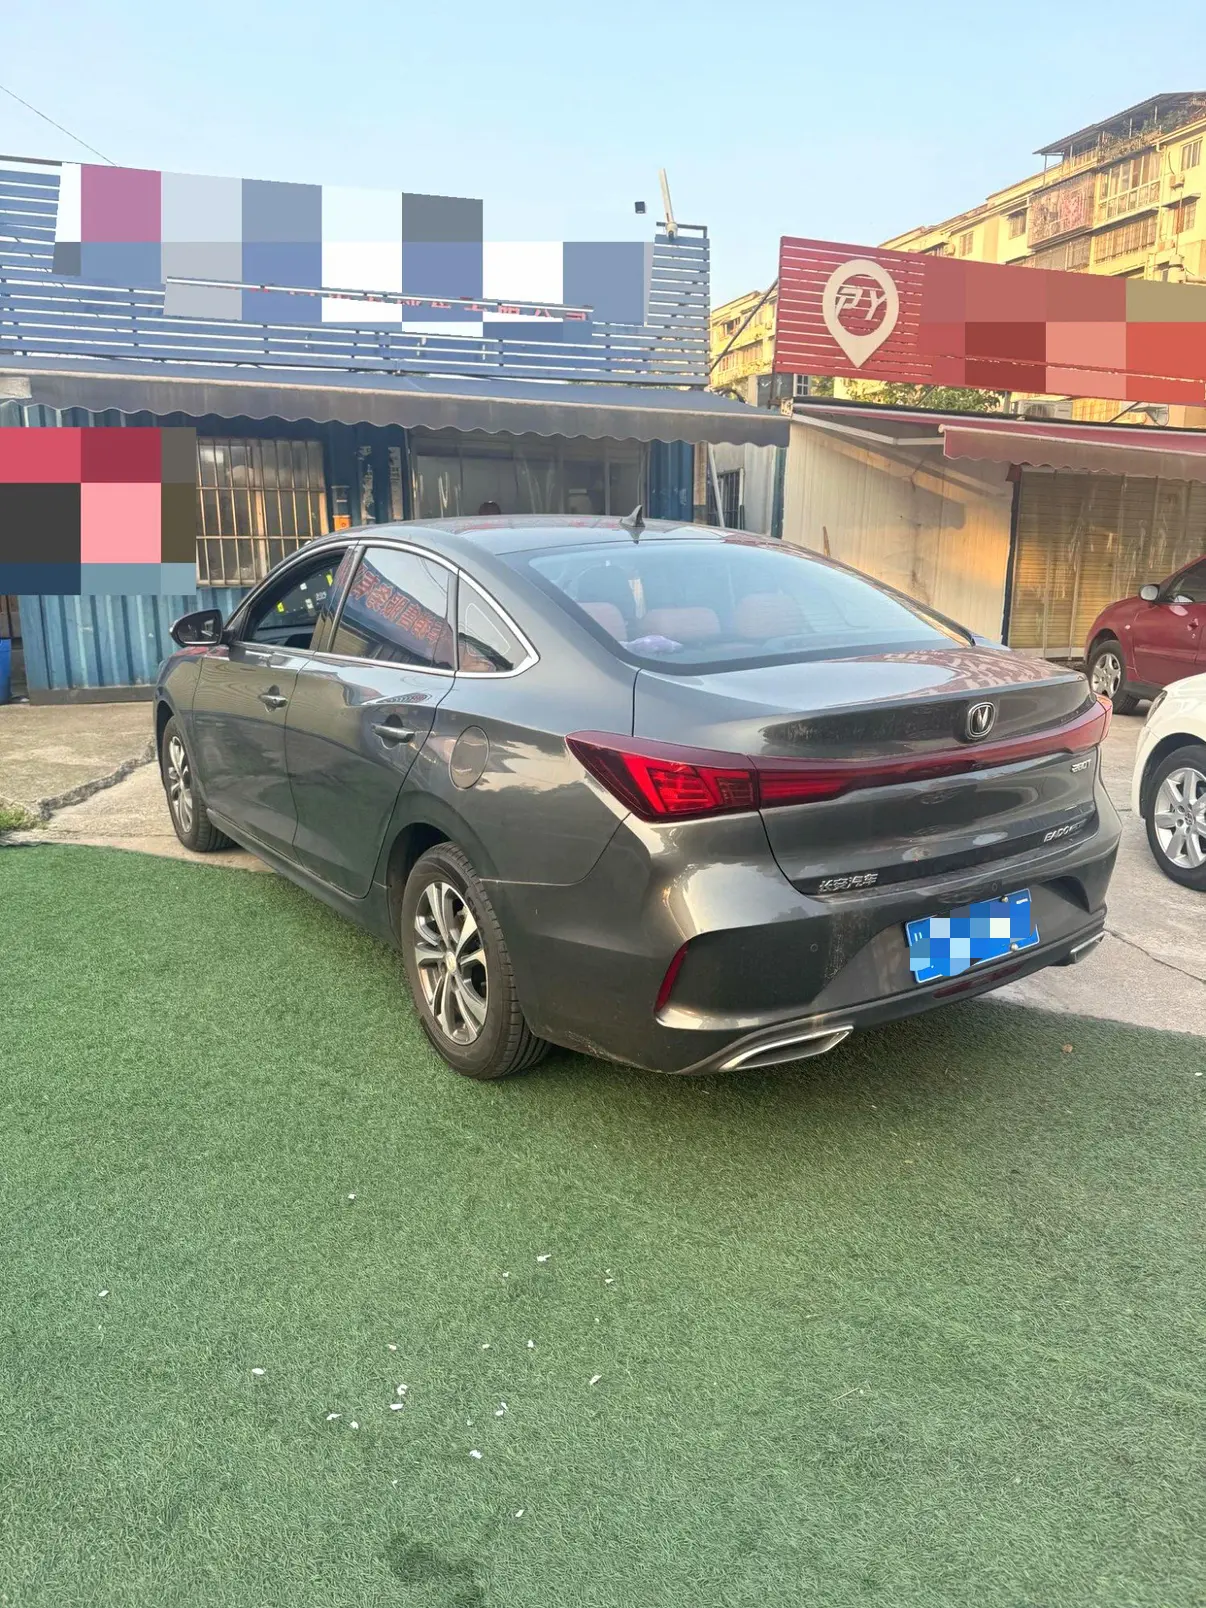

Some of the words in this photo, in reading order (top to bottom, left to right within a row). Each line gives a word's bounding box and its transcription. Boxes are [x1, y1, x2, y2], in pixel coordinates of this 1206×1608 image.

[836, 287, 887, 320] PY
[818, 873, 879, 893] 长安汽车
